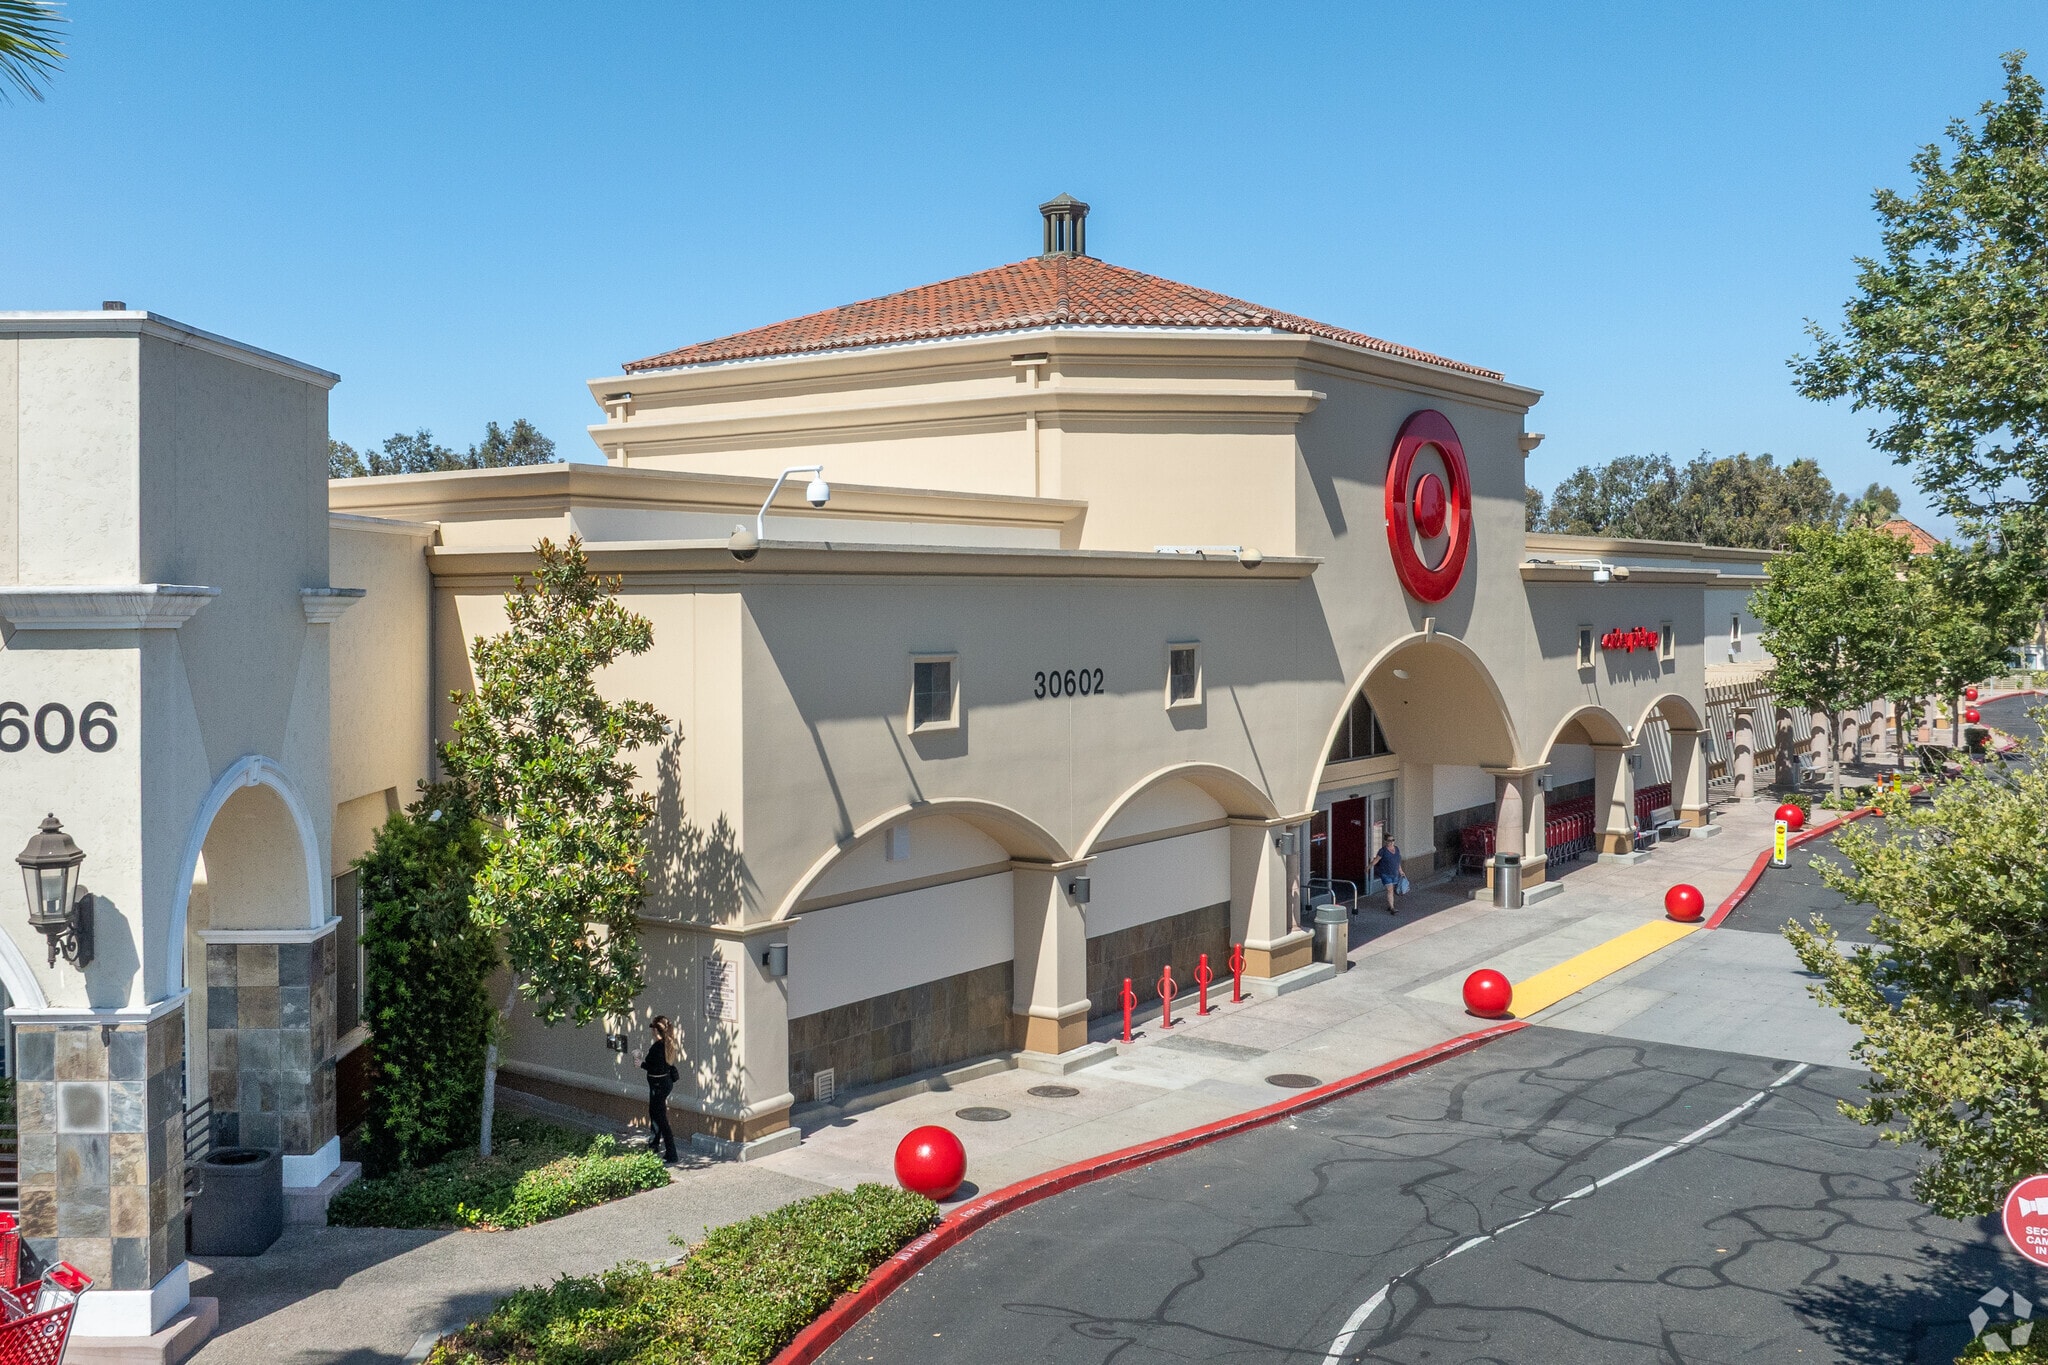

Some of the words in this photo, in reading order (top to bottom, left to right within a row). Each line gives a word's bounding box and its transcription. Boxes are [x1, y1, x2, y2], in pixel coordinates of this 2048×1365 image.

[1034, 668, 1104, 699] 30602
[0, 701, 118, 753] 606
[2025, 1226, 2048, 1237] SEC
[2026, 1236, 2048, 1246] CAM
[2035, 1246, 2047, 1256] IN
